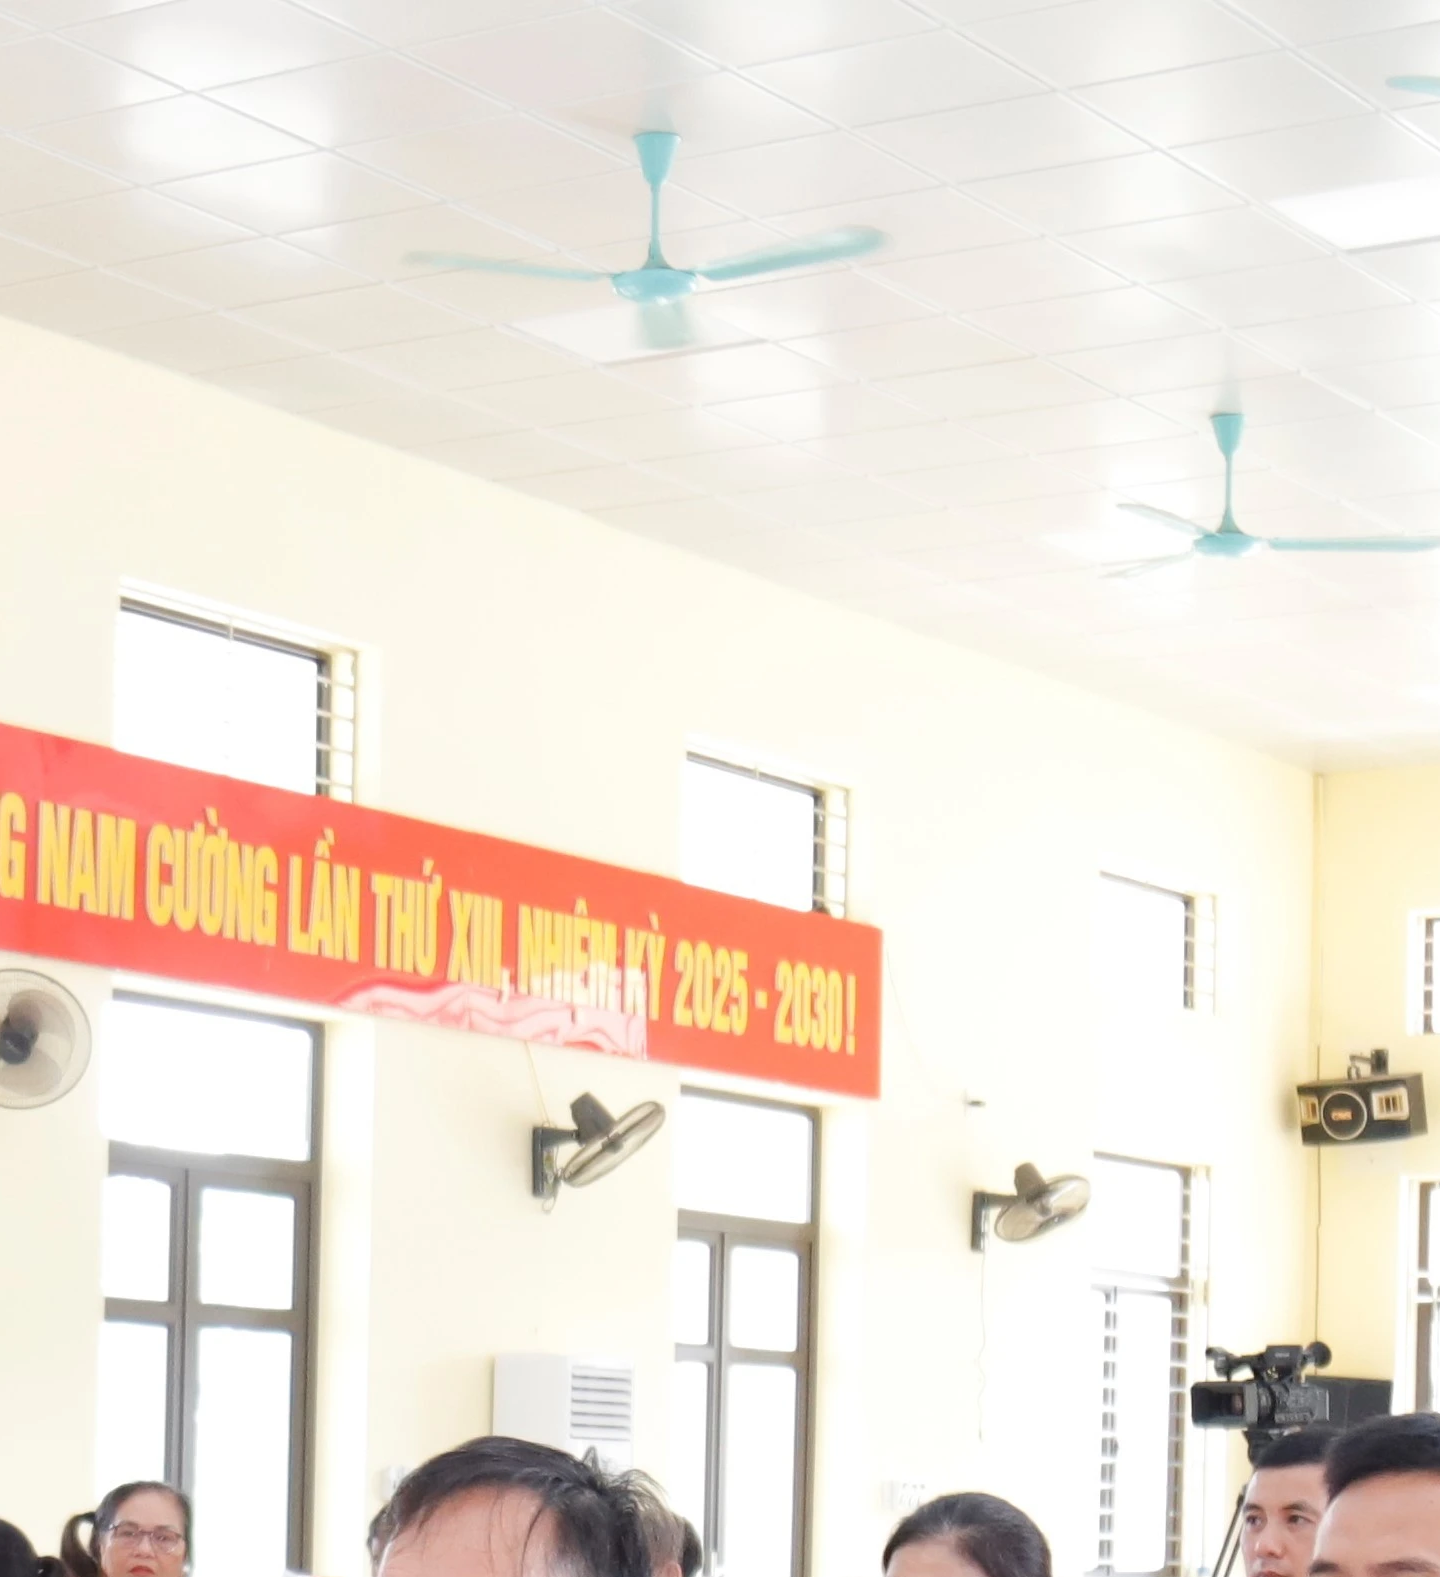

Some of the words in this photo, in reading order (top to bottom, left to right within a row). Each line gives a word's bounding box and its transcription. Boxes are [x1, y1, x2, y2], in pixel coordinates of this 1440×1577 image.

[38, 801, 138, 921] NAM
[146, 807, 280, 946] CƯỜNG
[288, 828, 363, 963] LẦN
[371, 858, 445, 978] THỨ
[622, 909, 669, 1023] KỲ
[673, 938, 751, 1037] 2025
[755, 989, 770, 1010] -
